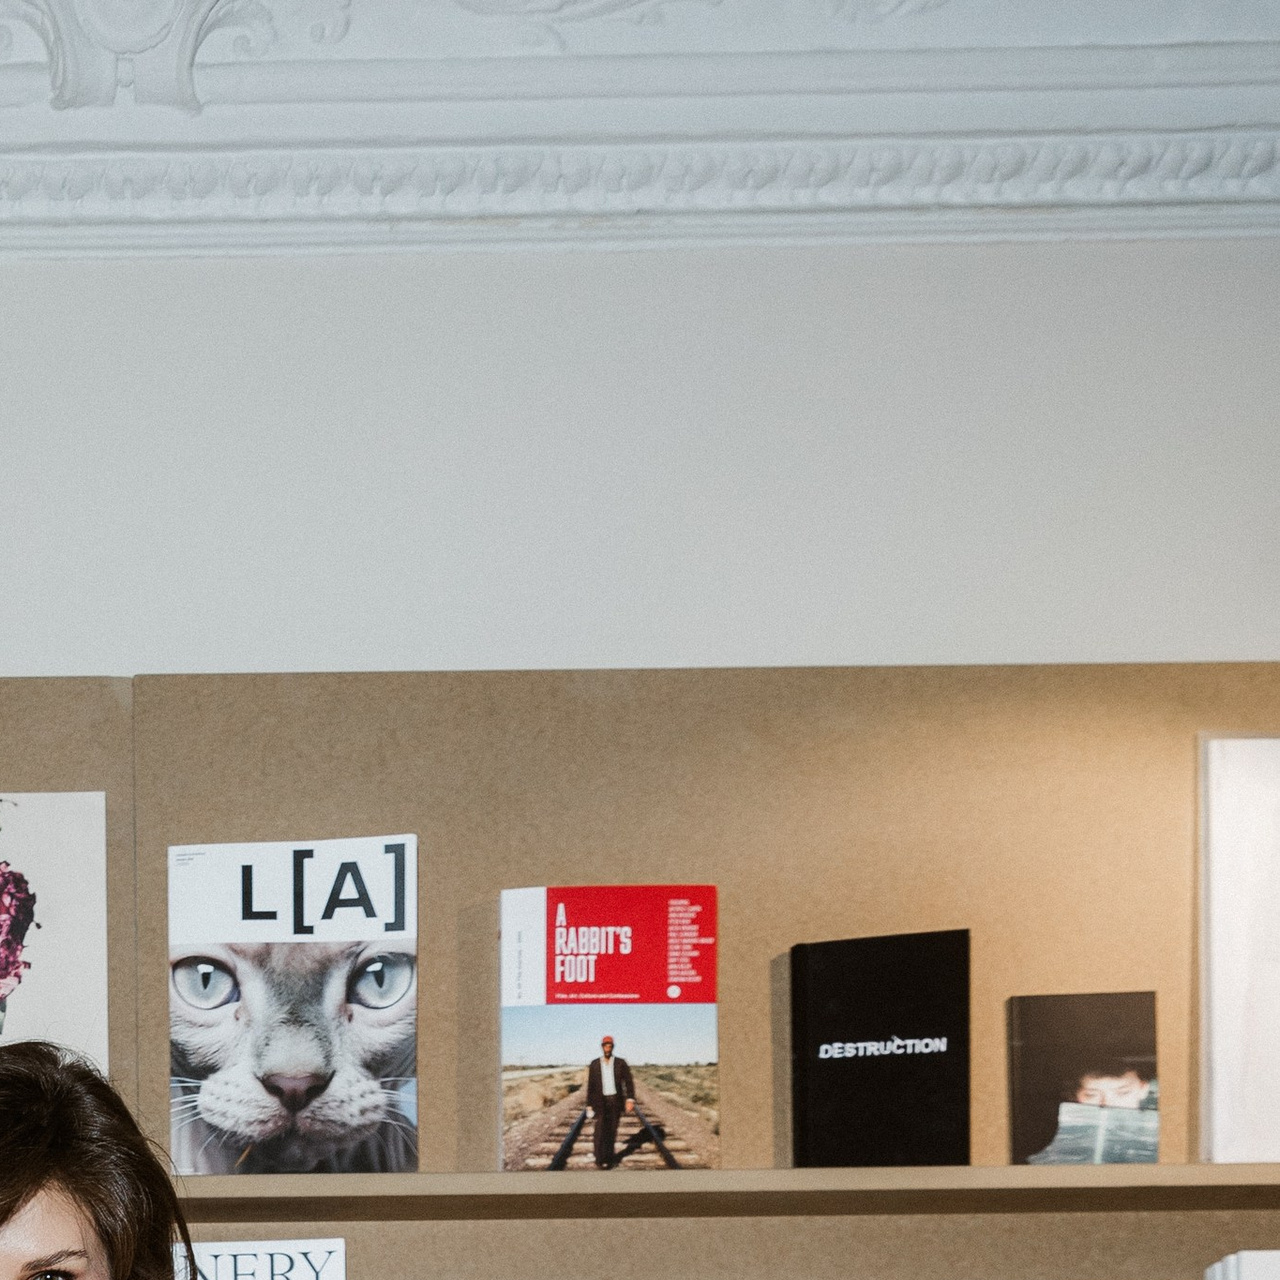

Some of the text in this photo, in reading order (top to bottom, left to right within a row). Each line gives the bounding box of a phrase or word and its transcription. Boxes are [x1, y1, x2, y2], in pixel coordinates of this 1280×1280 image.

[555, 902, 567, 926] A
[554, 926, 633, 956] RABBIT'S
[554, 954, 598, 983] FOOT
[818, 1036, 948, 1059] DESTRUCTION
